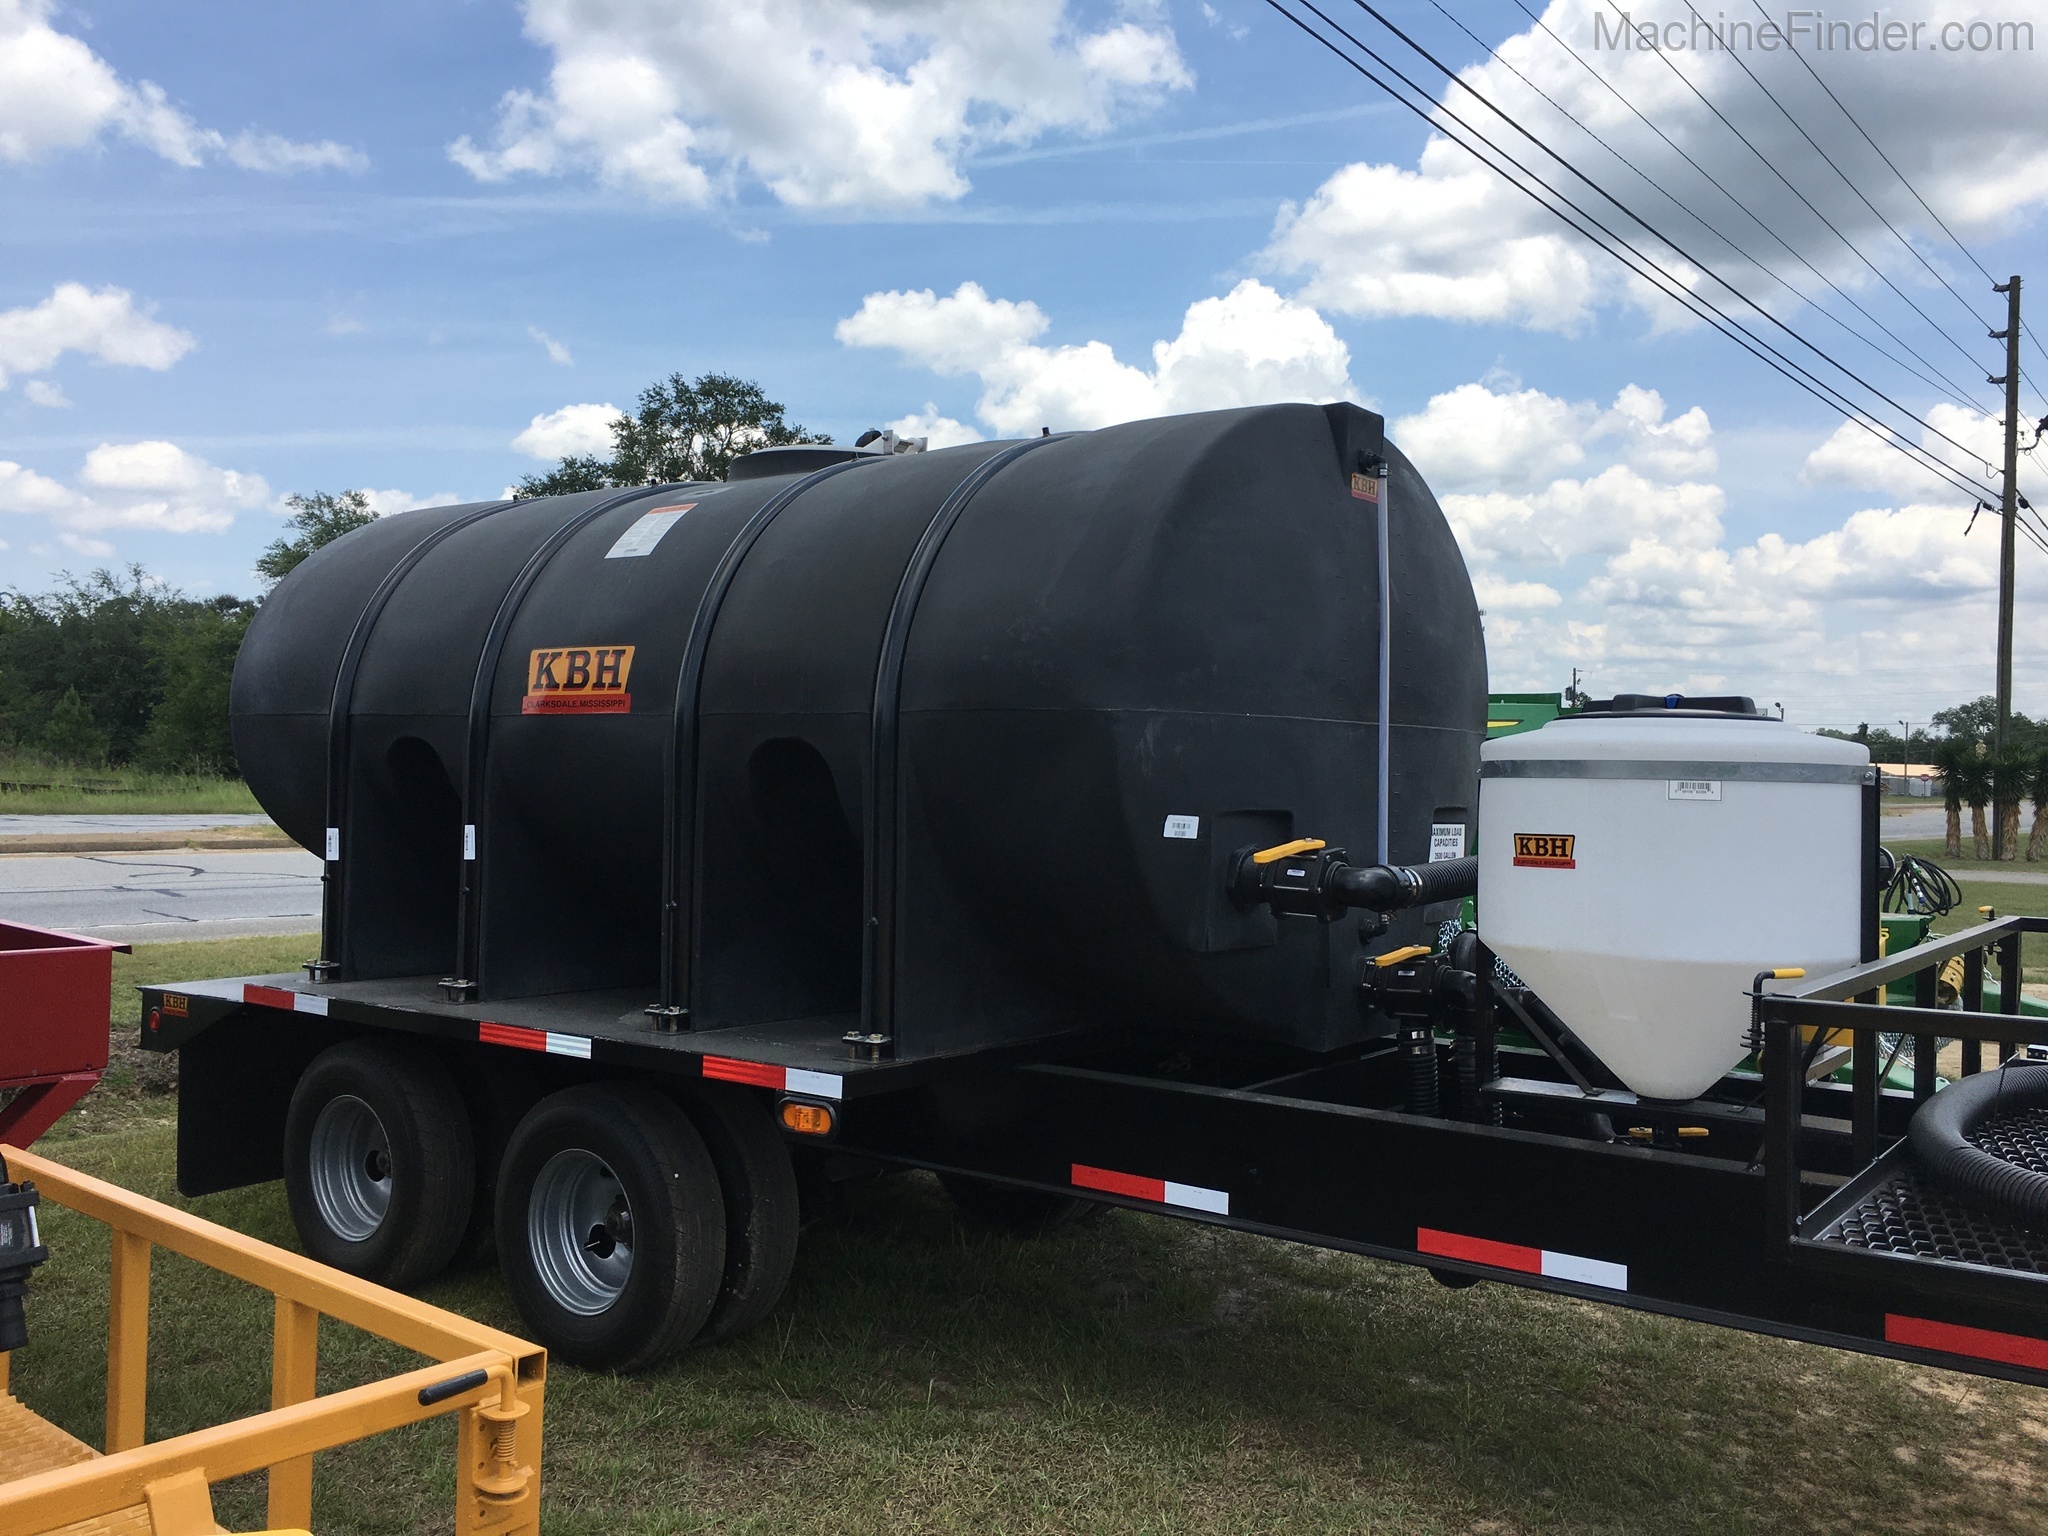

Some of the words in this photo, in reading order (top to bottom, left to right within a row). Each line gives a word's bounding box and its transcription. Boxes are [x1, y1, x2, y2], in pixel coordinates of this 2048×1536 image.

[1353, 476, 1376, 496] KBH
[531, 649, 627, 692] KBH
[1451, 827, 1462, 837] LOAD
[1433, 838, 1459, 847] CAPACITIES
[1518, 836, 1569, 857] KBH
[165, 994, 186, 1010] KBH
